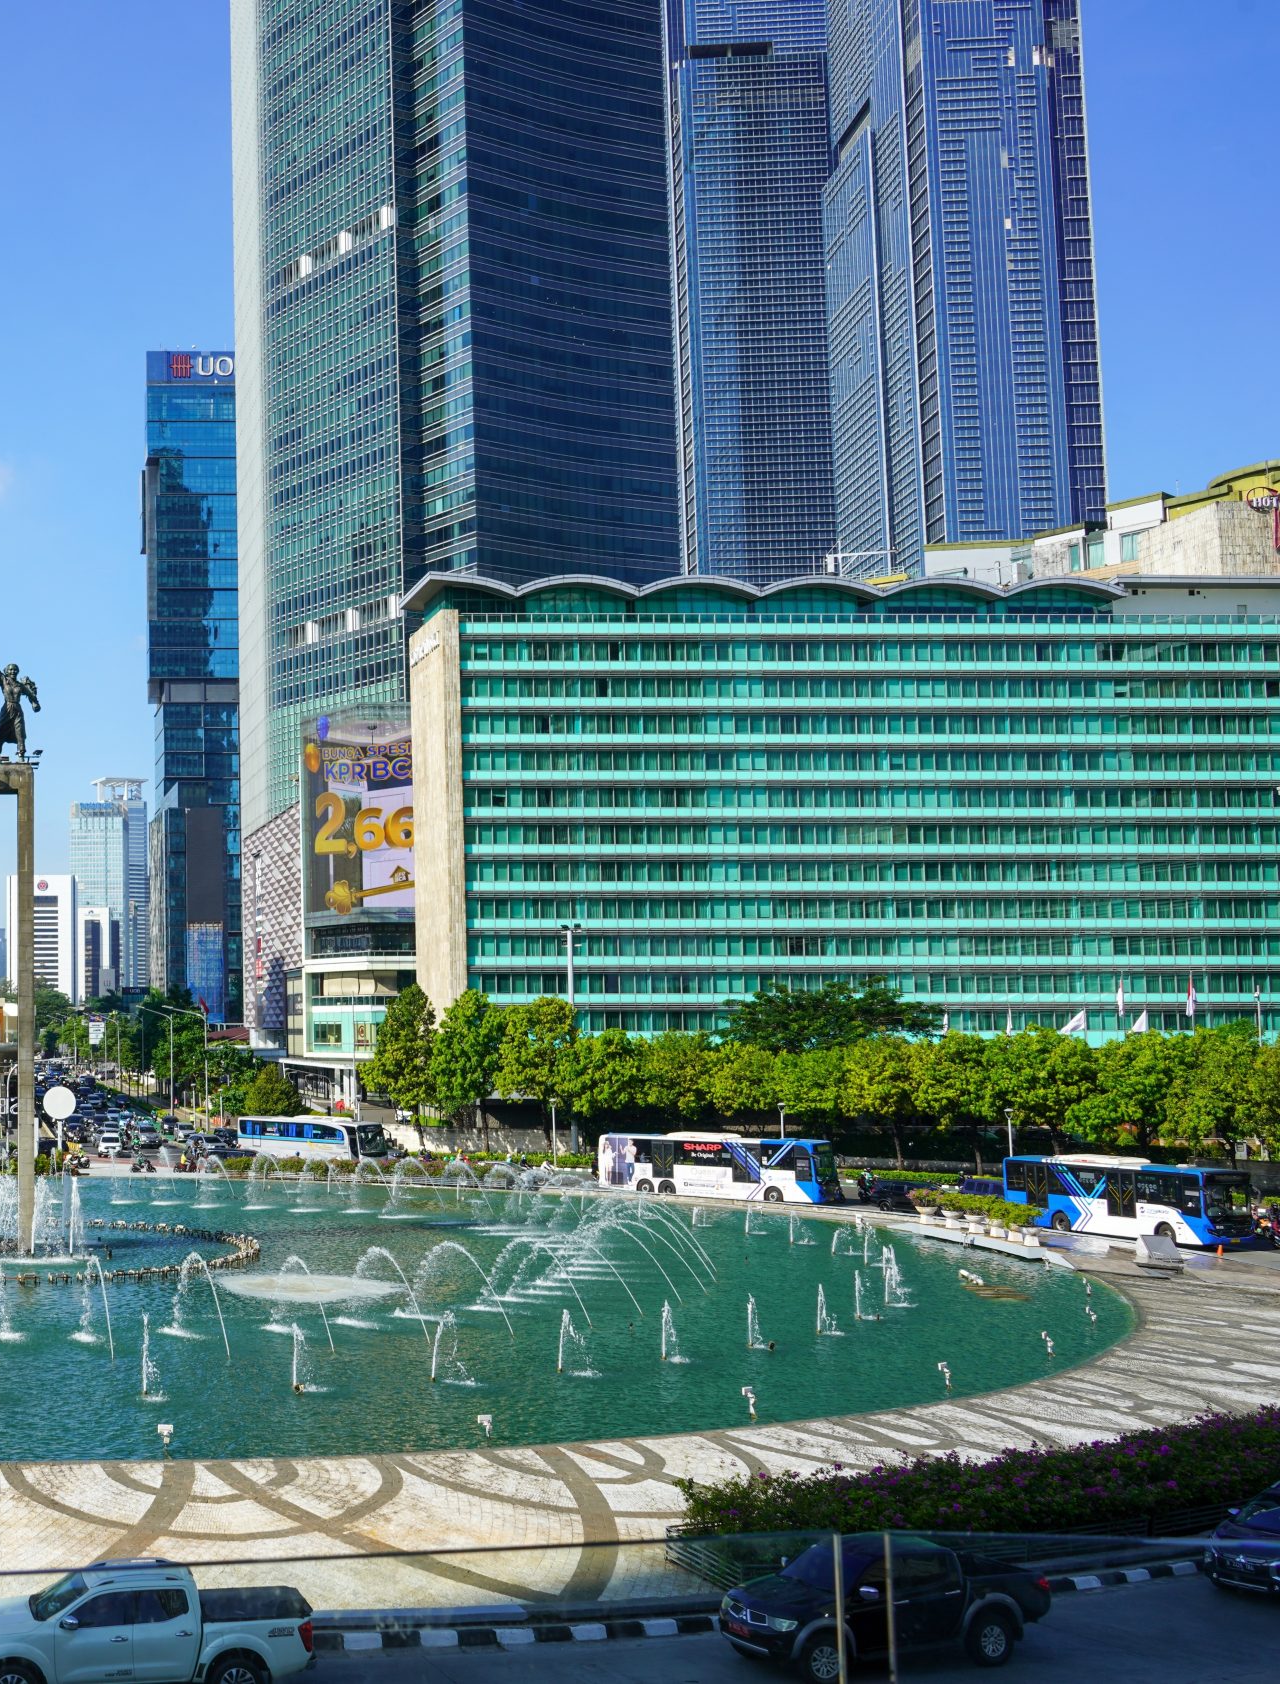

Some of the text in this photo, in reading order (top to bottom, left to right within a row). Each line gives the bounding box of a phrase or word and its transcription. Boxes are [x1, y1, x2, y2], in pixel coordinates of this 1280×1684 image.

[322, 747, 362, 760] BUNGA
[324, 757, 412, 781] KPR BC
[683, 1142, 722, 1151] SHARP
